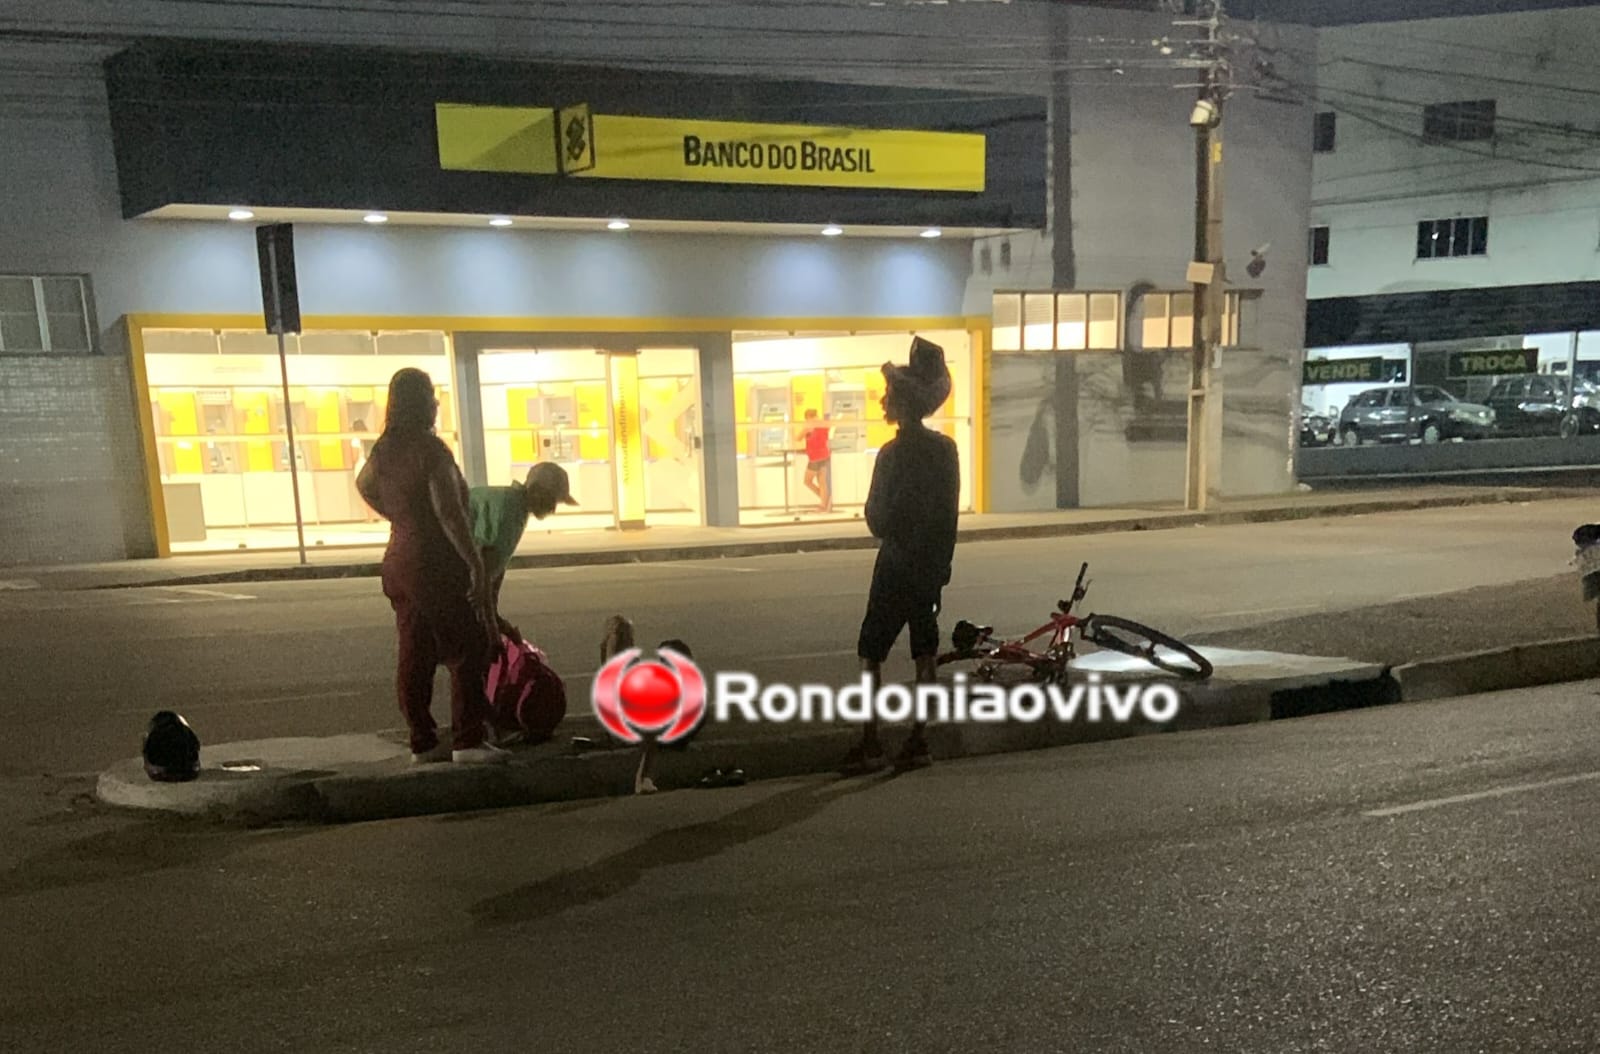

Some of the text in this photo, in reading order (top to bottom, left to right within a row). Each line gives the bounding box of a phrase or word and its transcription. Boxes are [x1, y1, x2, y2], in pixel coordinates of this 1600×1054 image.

[684, 135, 875, 173] BANCO DO BRASIL
[1306, 362, 1371, 380] VENDE
[1460, 354, 1527, 372] TROCA
